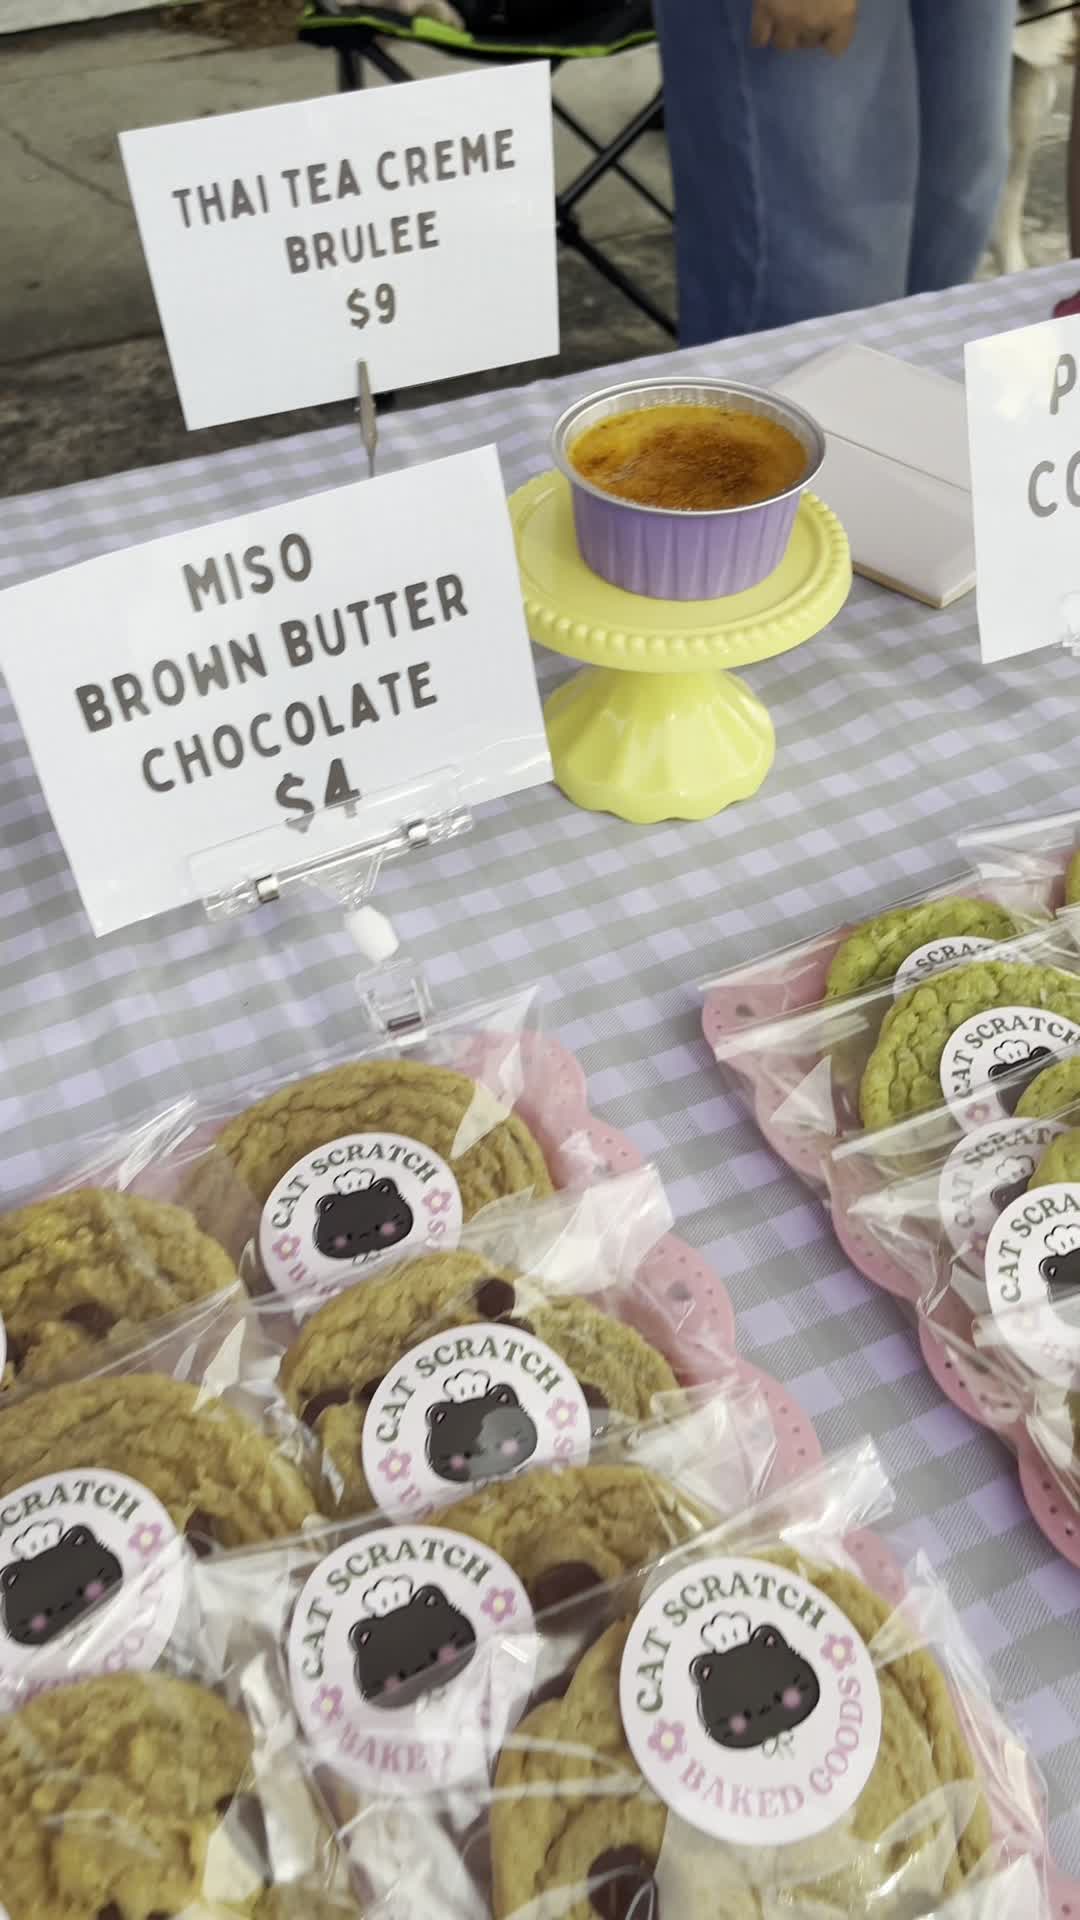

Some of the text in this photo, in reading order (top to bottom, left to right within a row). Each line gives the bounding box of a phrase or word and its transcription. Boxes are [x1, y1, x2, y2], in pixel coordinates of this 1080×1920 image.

[172, 128, 515, 228] THAI TEA CREME
[285, 210, 440, 274] BRULEE
[347, 283, 396, 329] $9
[182, 533, 313, 612] MISO
[75, 573, 468, 732] BROWN BUTTER
[142, 661, 438, 793] CHOCOLATE
[275, 758, 361, 833] $4
[271, 1143, 440, 1230] CAT SCRATCH
[998, 1240, 1022, 1303] CAT
[375, 1335, 564, 1444] CAT SCRATCH
[0, 1479, 141, 1530] CRATCH
[302, 1537, 493, 1680] CAT SCRATCH
[636, 1571, 828, 1714] CAT SCRATCH
[679, 1675, 864, 1818] BAKED GOODS
